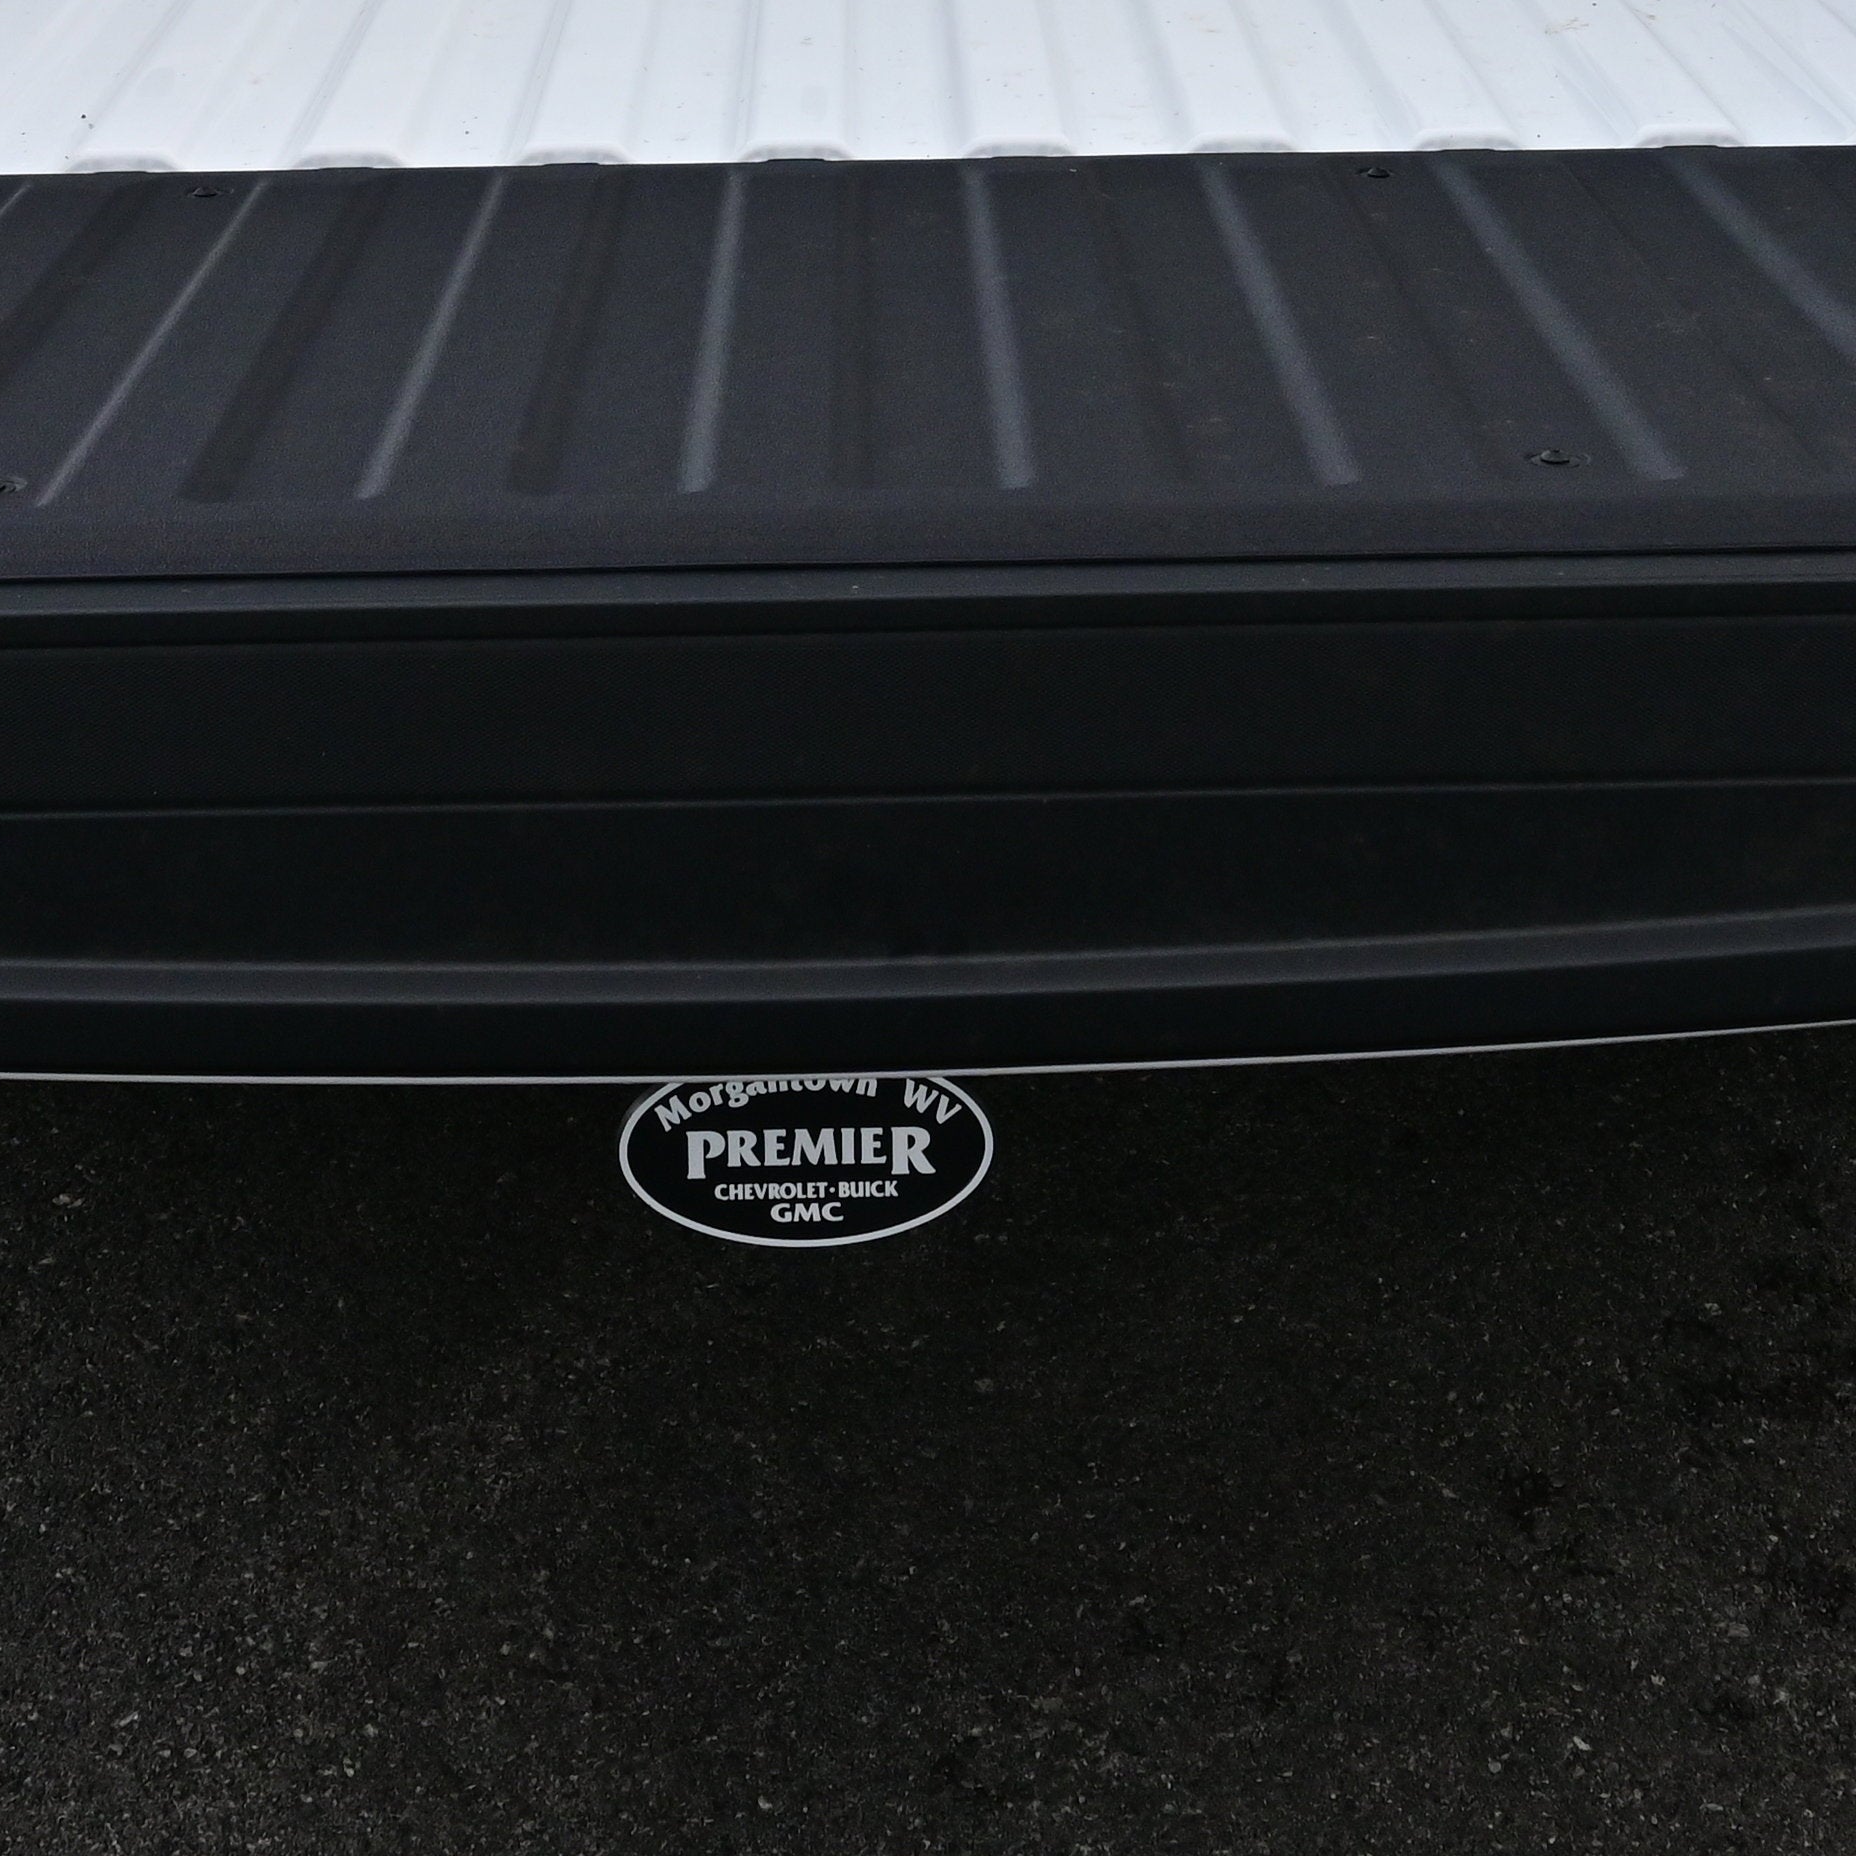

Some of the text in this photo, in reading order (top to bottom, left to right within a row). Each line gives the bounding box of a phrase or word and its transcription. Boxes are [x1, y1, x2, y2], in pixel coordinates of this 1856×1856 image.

[654, 1078, 962, 1132] Morgantown WV
[685, 1126, 937, 1180] PREMIER
[714, 1180, 899, 1201] CHEVROLET BUICK
[770, 1202, 844, 1223] GMC
